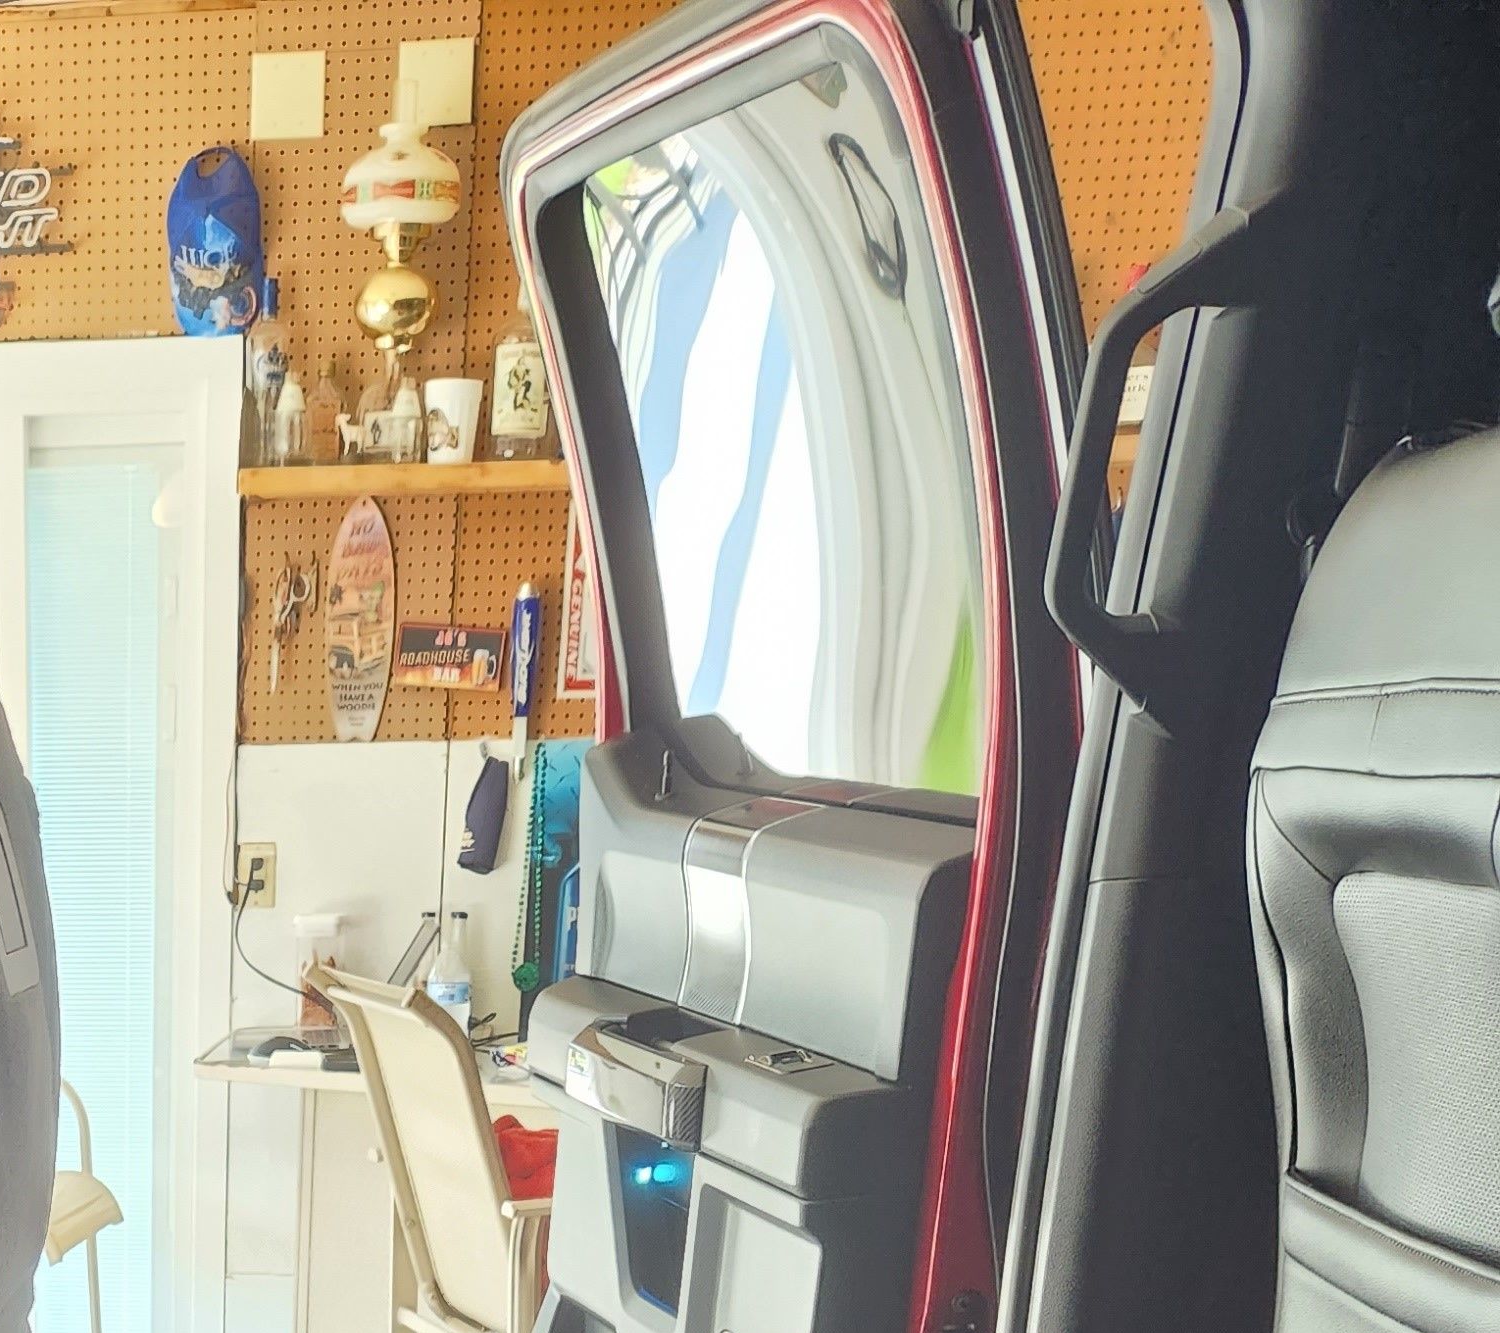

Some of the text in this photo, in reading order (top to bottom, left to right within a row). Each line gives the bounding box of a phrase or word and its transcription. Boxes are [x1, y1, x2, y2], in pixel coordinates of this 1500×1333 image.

[565, 578, 583, 682] GENUINE
[399, 648, 472, 667] ROADHOUSE
[433, 666, 461, 683] BAR
